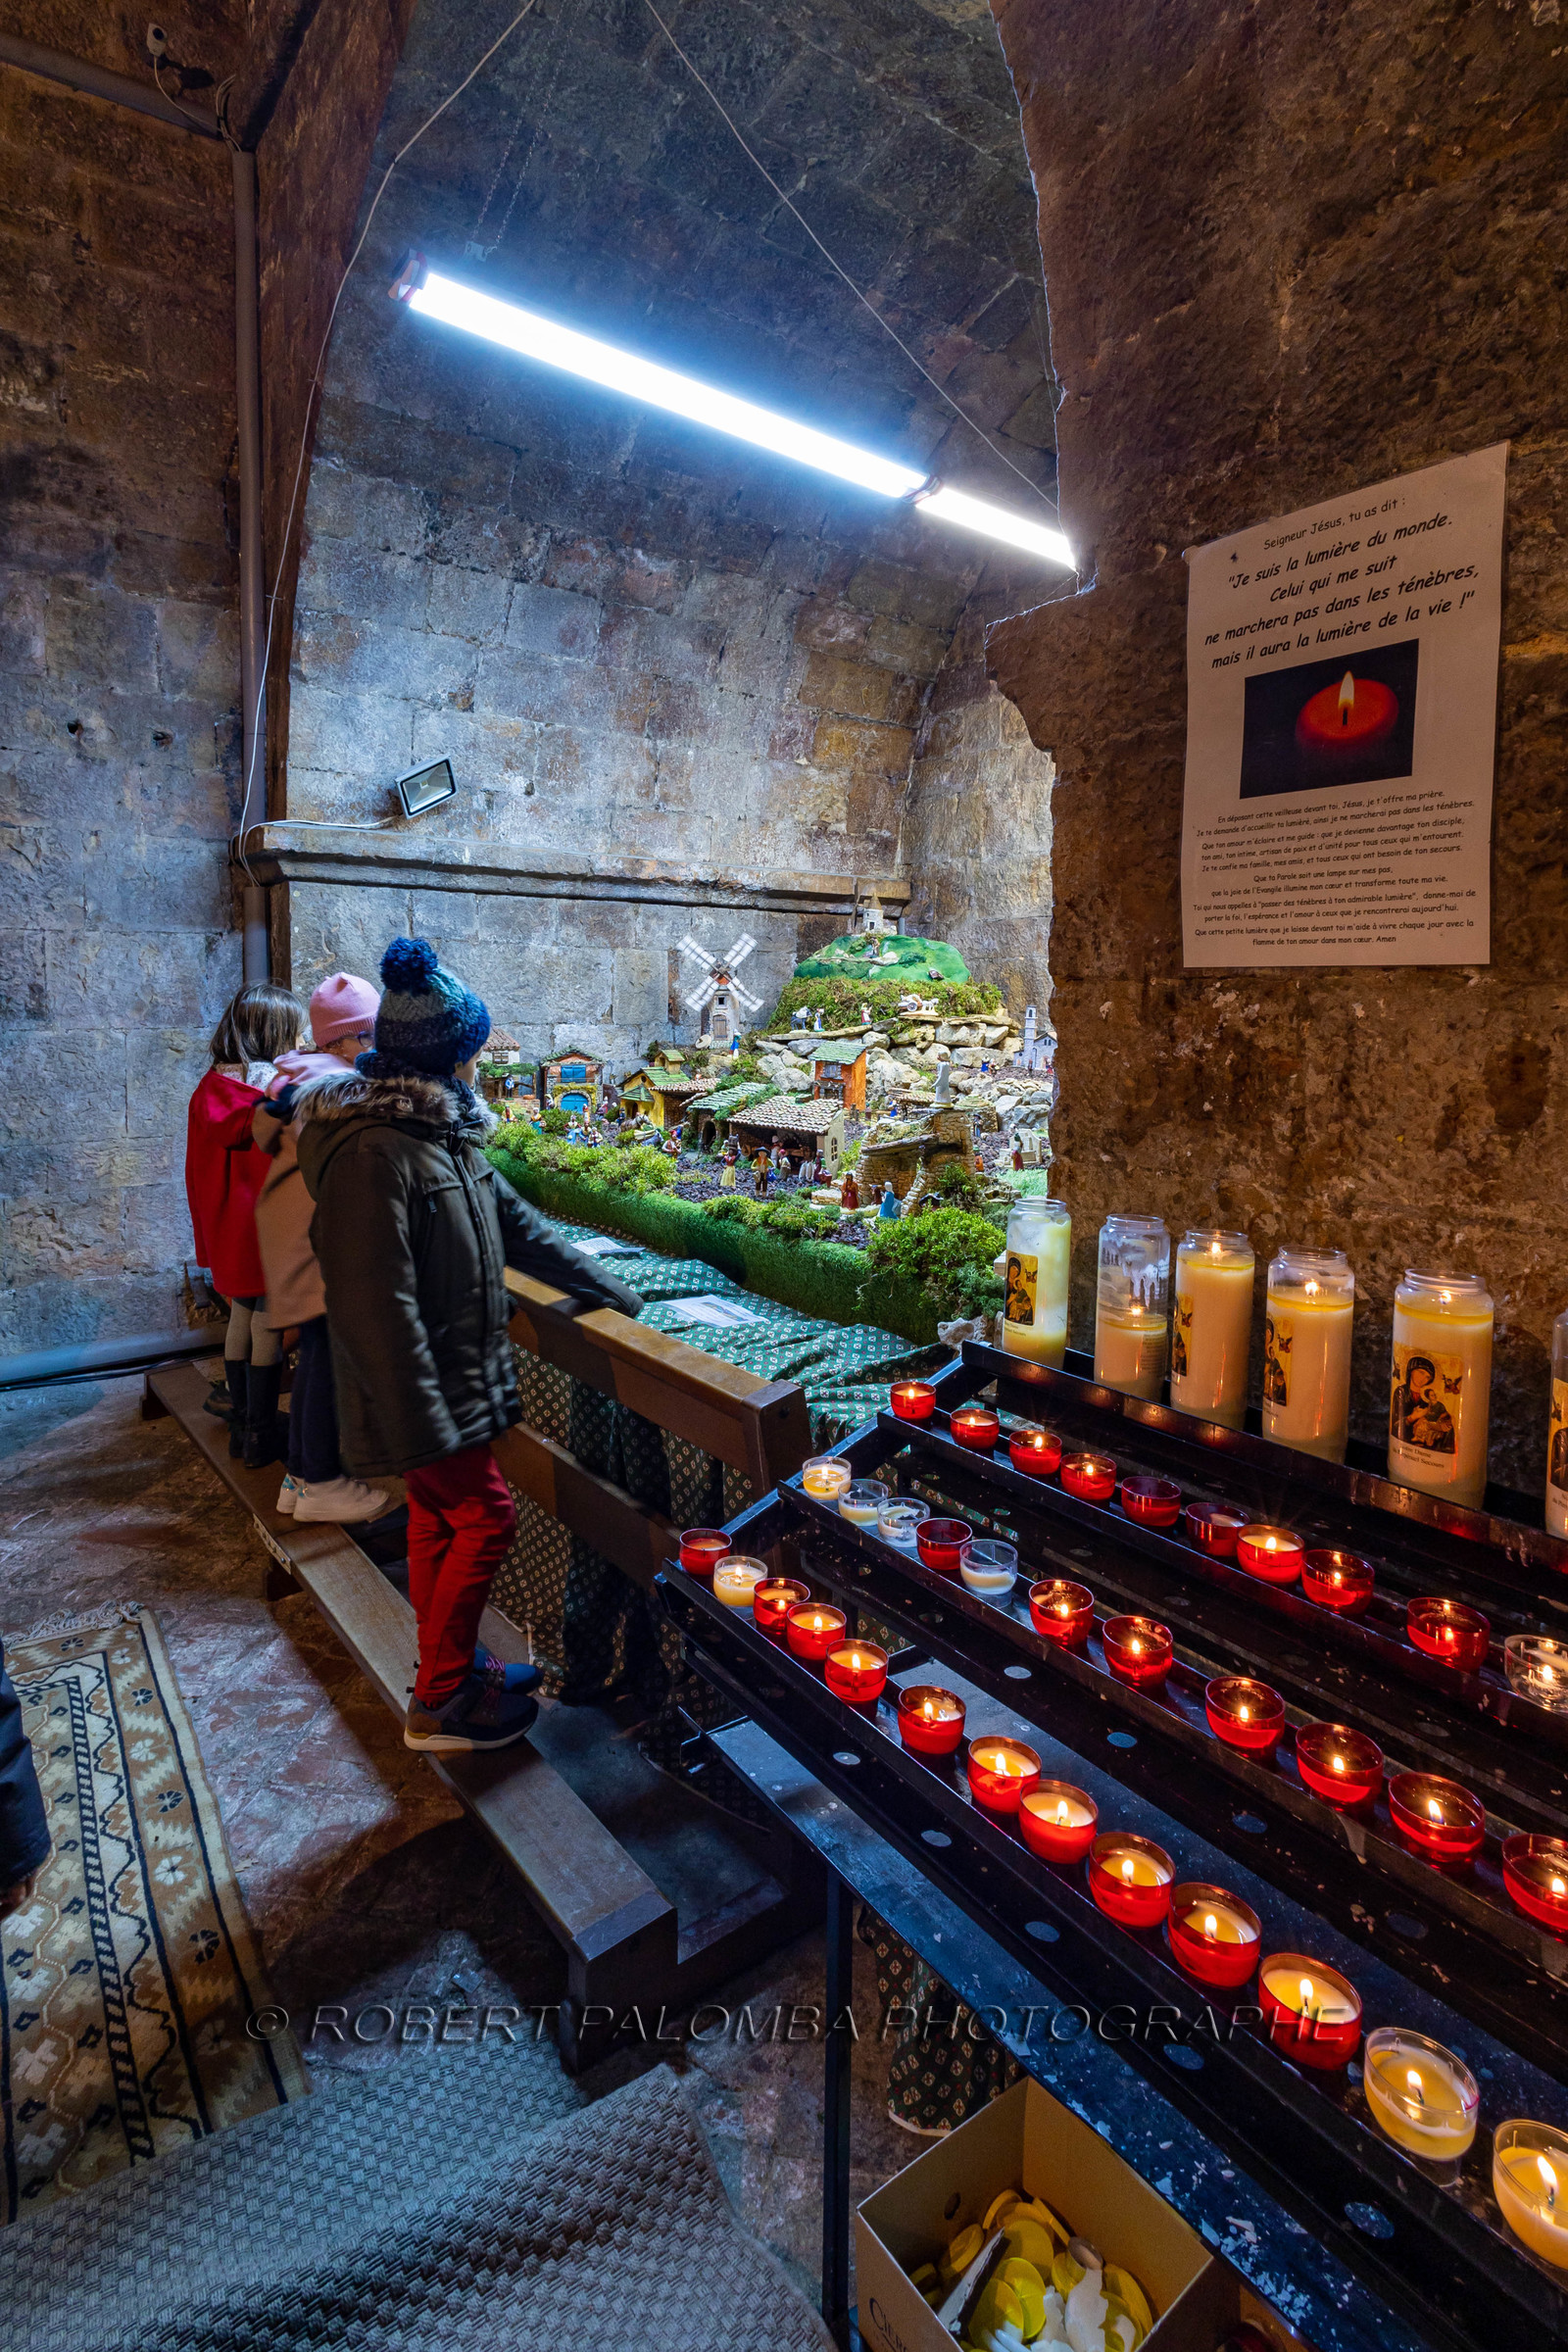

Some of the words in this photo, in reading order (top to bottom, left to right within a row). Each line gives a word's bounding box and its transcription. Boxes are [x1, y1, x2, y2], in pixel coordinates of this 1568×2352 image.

[1263, 529, 1307, 550] Seigneur
[1310, 517, 1345, 535] Jésus,
[1348, 512, 1361, 522] tu
[1364, 507, 1377, 517] as
[1381, 499, 1398, 513] dit
[1254, 563, 1281, 582] suis
[1286, 557, 1299, 572] la
[1304, 541, 1360, 566] lumière
[1367, 530, 1388, 548] du
[1393, 513, 1452, 541] monde.
[1270, 580, 1305, 602] Celui
[1309, 572, 1332, 595] qui
[1336, 568, 1359, 584] me
[1365, 555, 1397, 576] suit
[1204, 633, 1220, 646] ne
[1225, 614, 1289, 641] marchera
[1293, 606, 1320, 627] pas
[1325, 596, 1361, 613] dans
[1366, 587, 1391, 604] les
[1397, 564, 1479, 596] ténèbres,
[1211, 651, 1241, 668] mais
[1246, 645, 1255, 661] il
[1259, 641, 1291, 657] aura
[1297, 633, 1309, 648] la
[1315, 620, 1371, 644] lumière
[1378, 612, 1398, 628] de
[1404, 606, 1420, 622] la
[1429, 599, 1452, 616] vie
[1213, 826, 1240, 835] demande
[1330, 815, 1338, 824] je
[1349, 809, 1387, 820] marcherai
[1388, 808, 1401, 817] pas
[1227, 813, 1254, 823] déposant
[1303, 805, 1327, 813] devant
[1366, 799, 1375, 808] je
[1298, 832, 1315, 842] guide
[1335, 830, 1343, 839] je
[1344, 827, 1375, 836] devienne
[1377, 823, 1415, 832] davantage
[1227, 902, 1251, 911] appelles
[1348, 895, 1383, 904] admirable
[1423, 890, 1464, 900] donne-moi
[1230, 889, 1242, 898] joie
[1354, 879, 1396, 888] transforme
[1353, 908, 1361, 917] je
[1363, 906, 1410, 915] rencontrerai
[1282, 926, 1290, 935] je
[1398, 921, 1425, 931] chaque
[1427, 921, 1445, 930] jour
[1467, 918, 1474, 927] la
